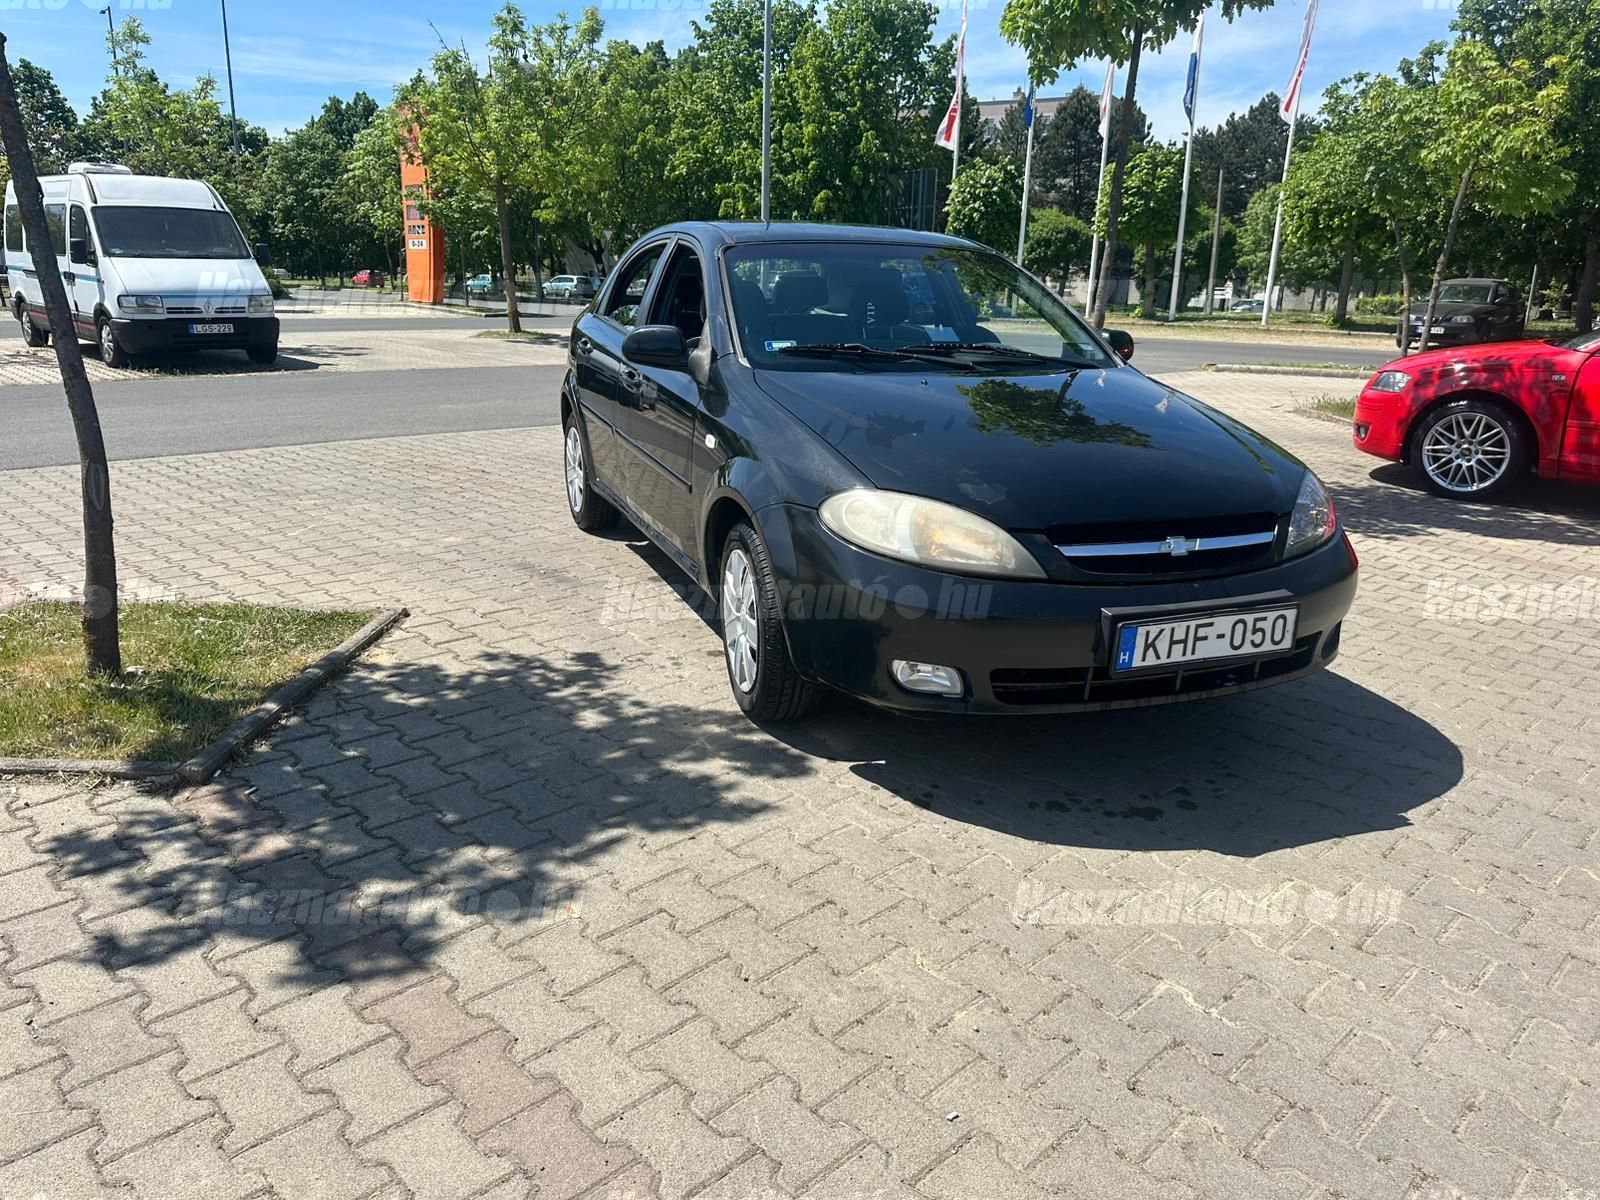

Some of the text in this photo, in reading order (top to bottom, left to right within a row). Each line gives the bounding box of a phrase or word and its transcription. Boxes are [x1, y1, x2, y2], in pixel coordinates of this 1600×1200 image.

[195, 325, 232, 333] LGS-229
[1141, 614, 1288, 662] KHF-050
[1119, 651, 1129, 663] H
